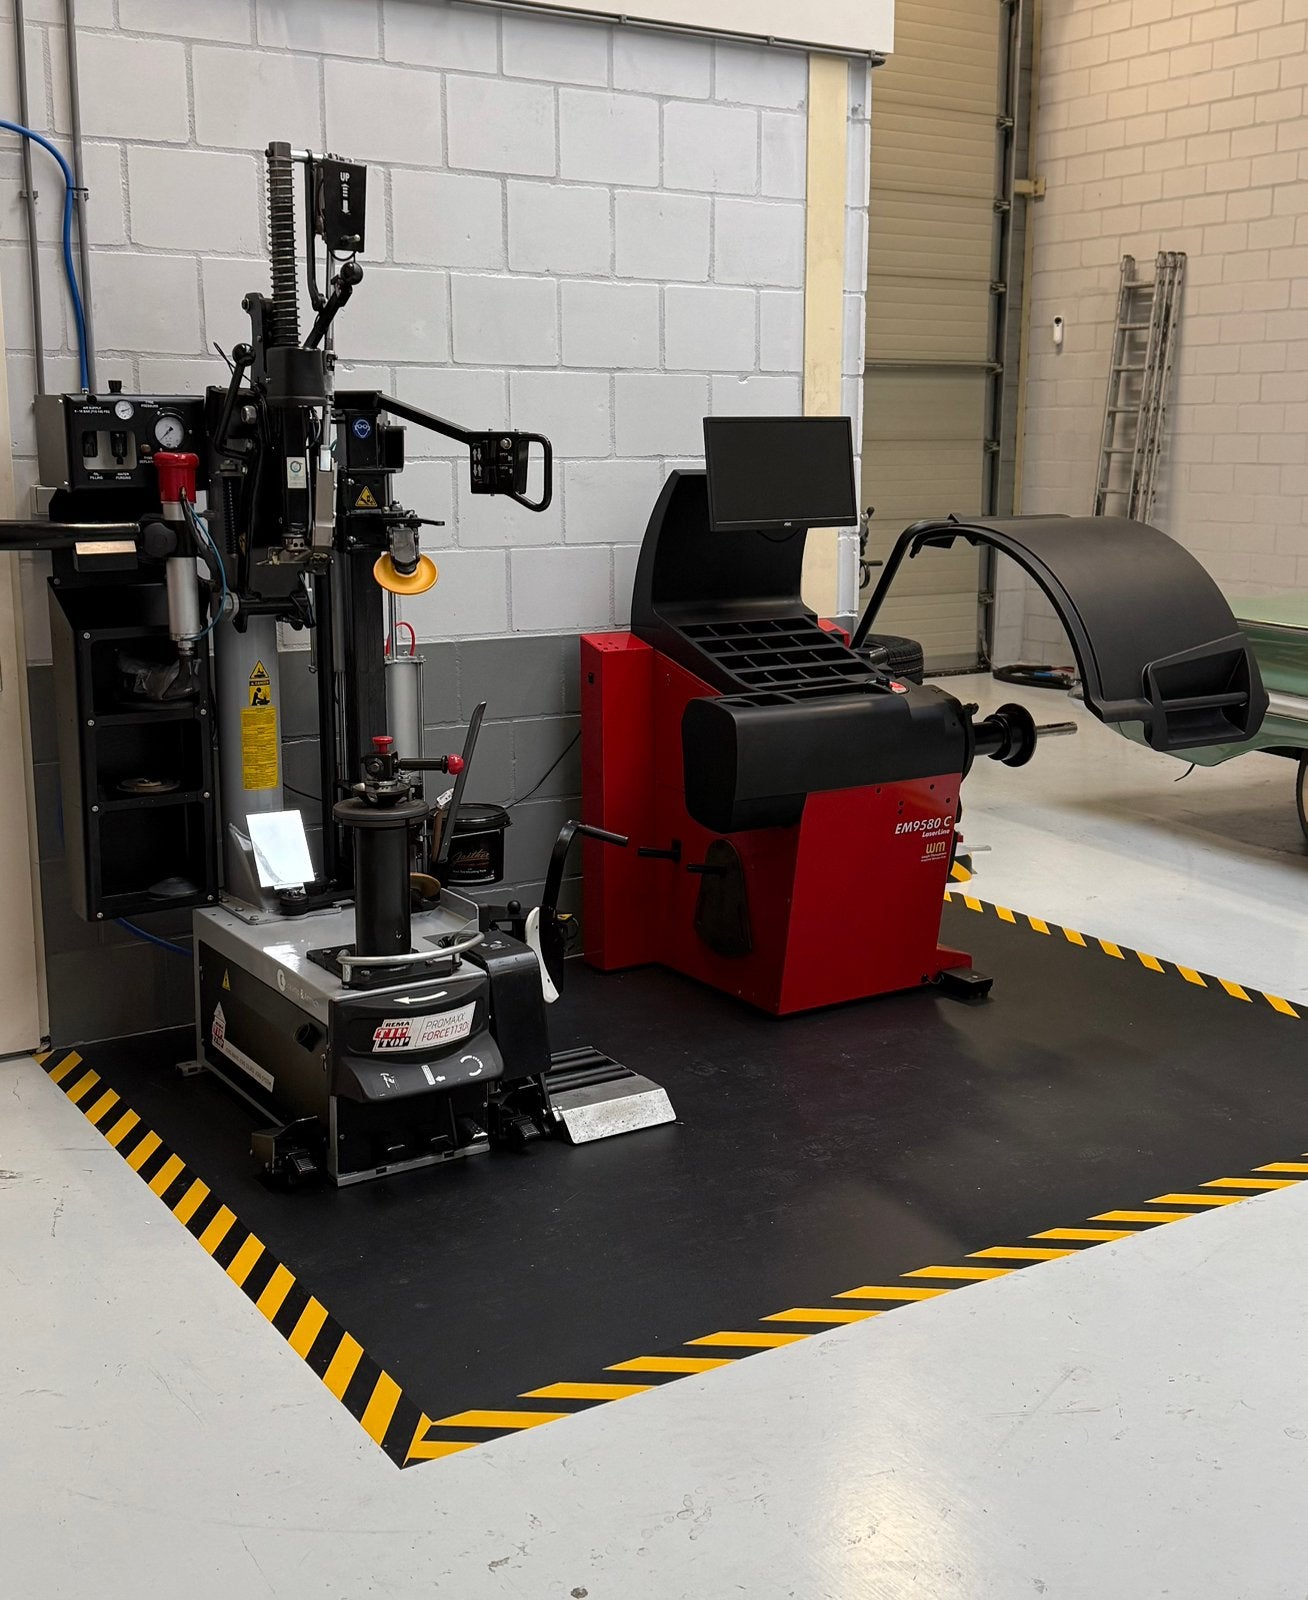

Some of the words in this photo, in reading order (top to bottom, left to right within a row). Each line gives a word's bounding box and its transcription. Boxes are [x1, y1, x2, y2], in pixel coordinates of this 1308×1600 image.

[340, 171, 351, 182] UP
[895, 817, 942, 835] EM9580
[943, 815, 952, 827] C
[921, 828, 951, 838] LaserLine
[384, 1020, 410, 1028] REMA
[425, 1012, 466, 1031] PROMAXX
[375, 1027, 409, 1039] TIP
[377, 1037, 411, 1048] TOP
